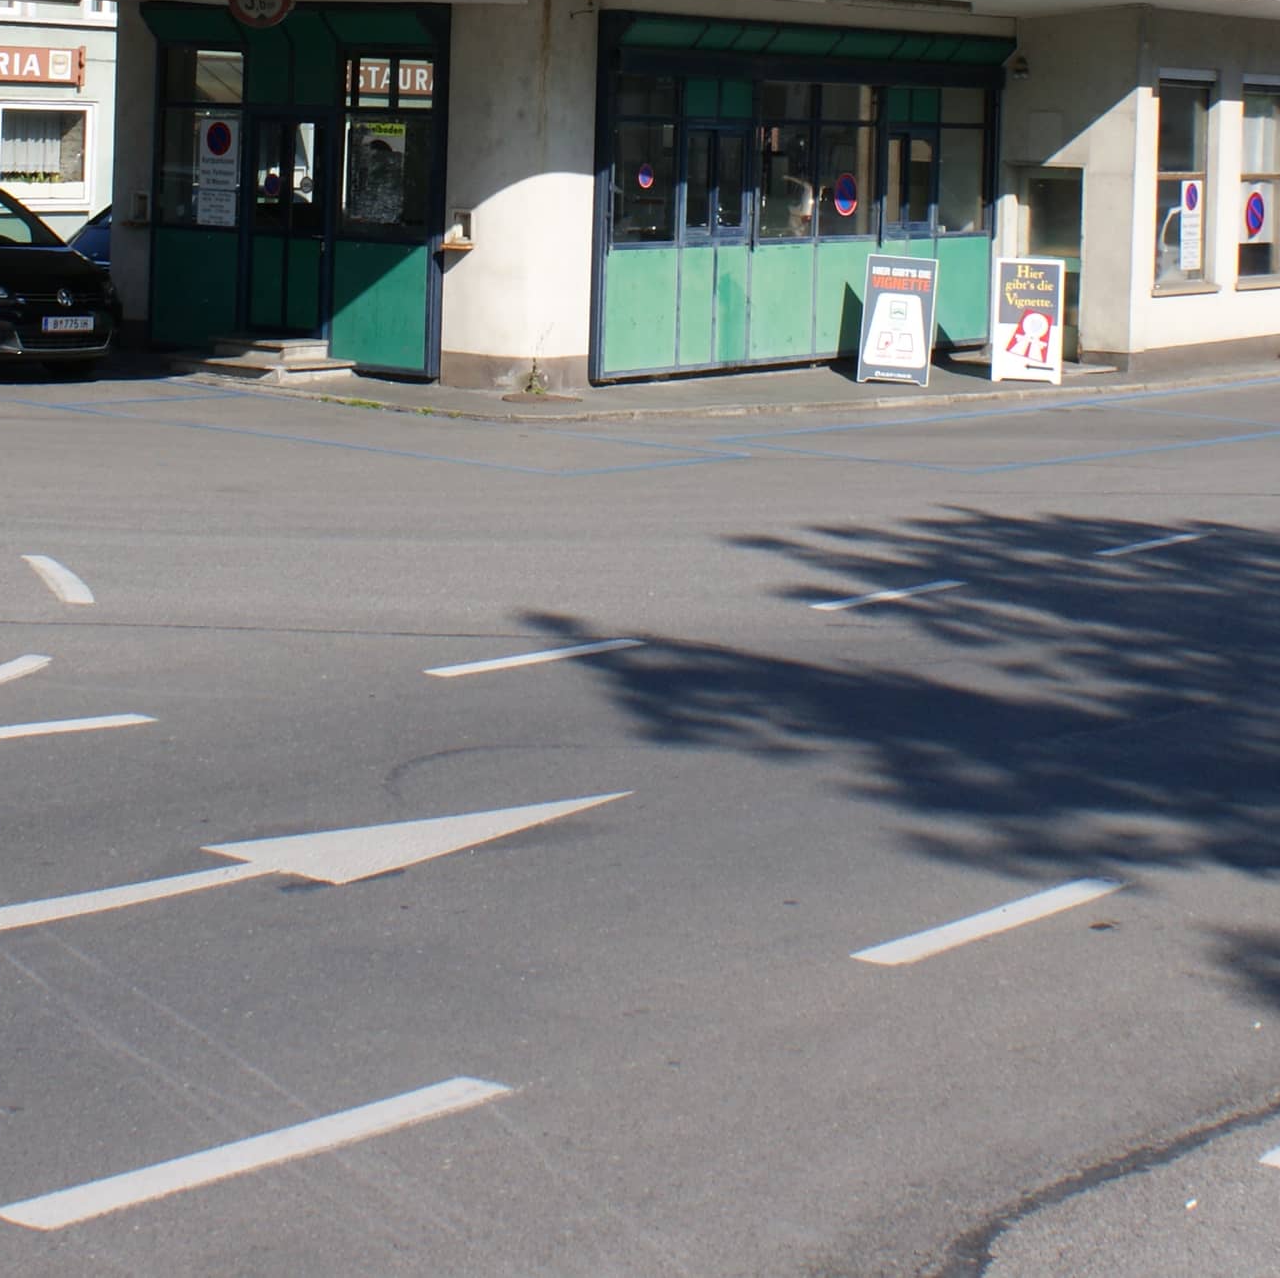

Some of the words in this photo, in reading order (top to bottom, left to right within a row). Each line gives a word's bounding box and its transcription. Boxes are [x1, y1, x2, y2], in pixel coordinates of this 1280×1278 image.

[1016, 264, 1044, 279] Hier
[871, 275, 931, 293] VIGNETTE
[1005, 278, 1035, 292] gibt's
[1036, 280, 1054, 291] die
